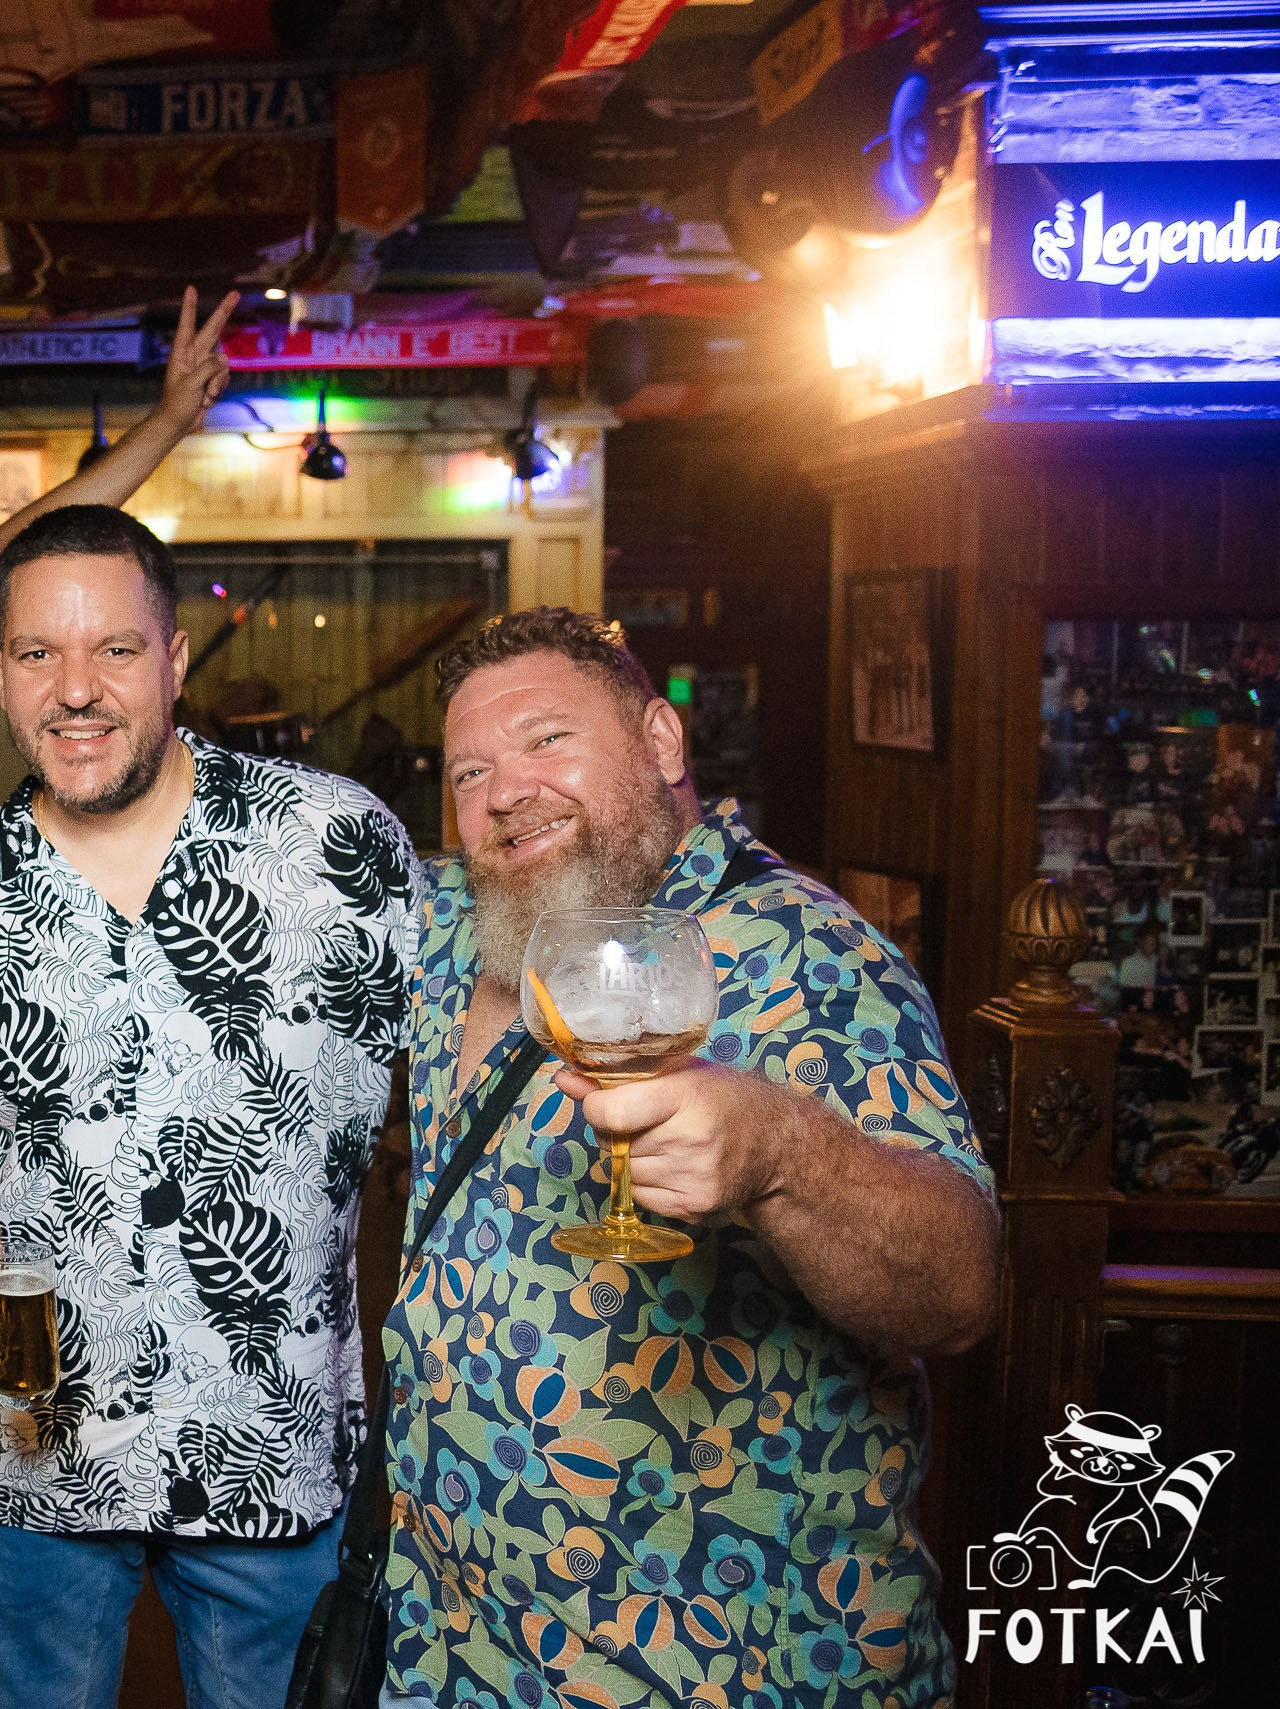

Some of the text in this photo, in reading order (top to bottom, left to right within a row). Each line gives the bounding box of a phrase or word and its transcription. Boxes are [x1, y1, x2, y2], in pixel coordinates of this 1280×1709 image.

[160, 80, 308, 132] FORZA
[1076, 190, 1280, 293] Legenda
[92, 336, 118, 356] FC
[449, 330, 518, 356] BEST
